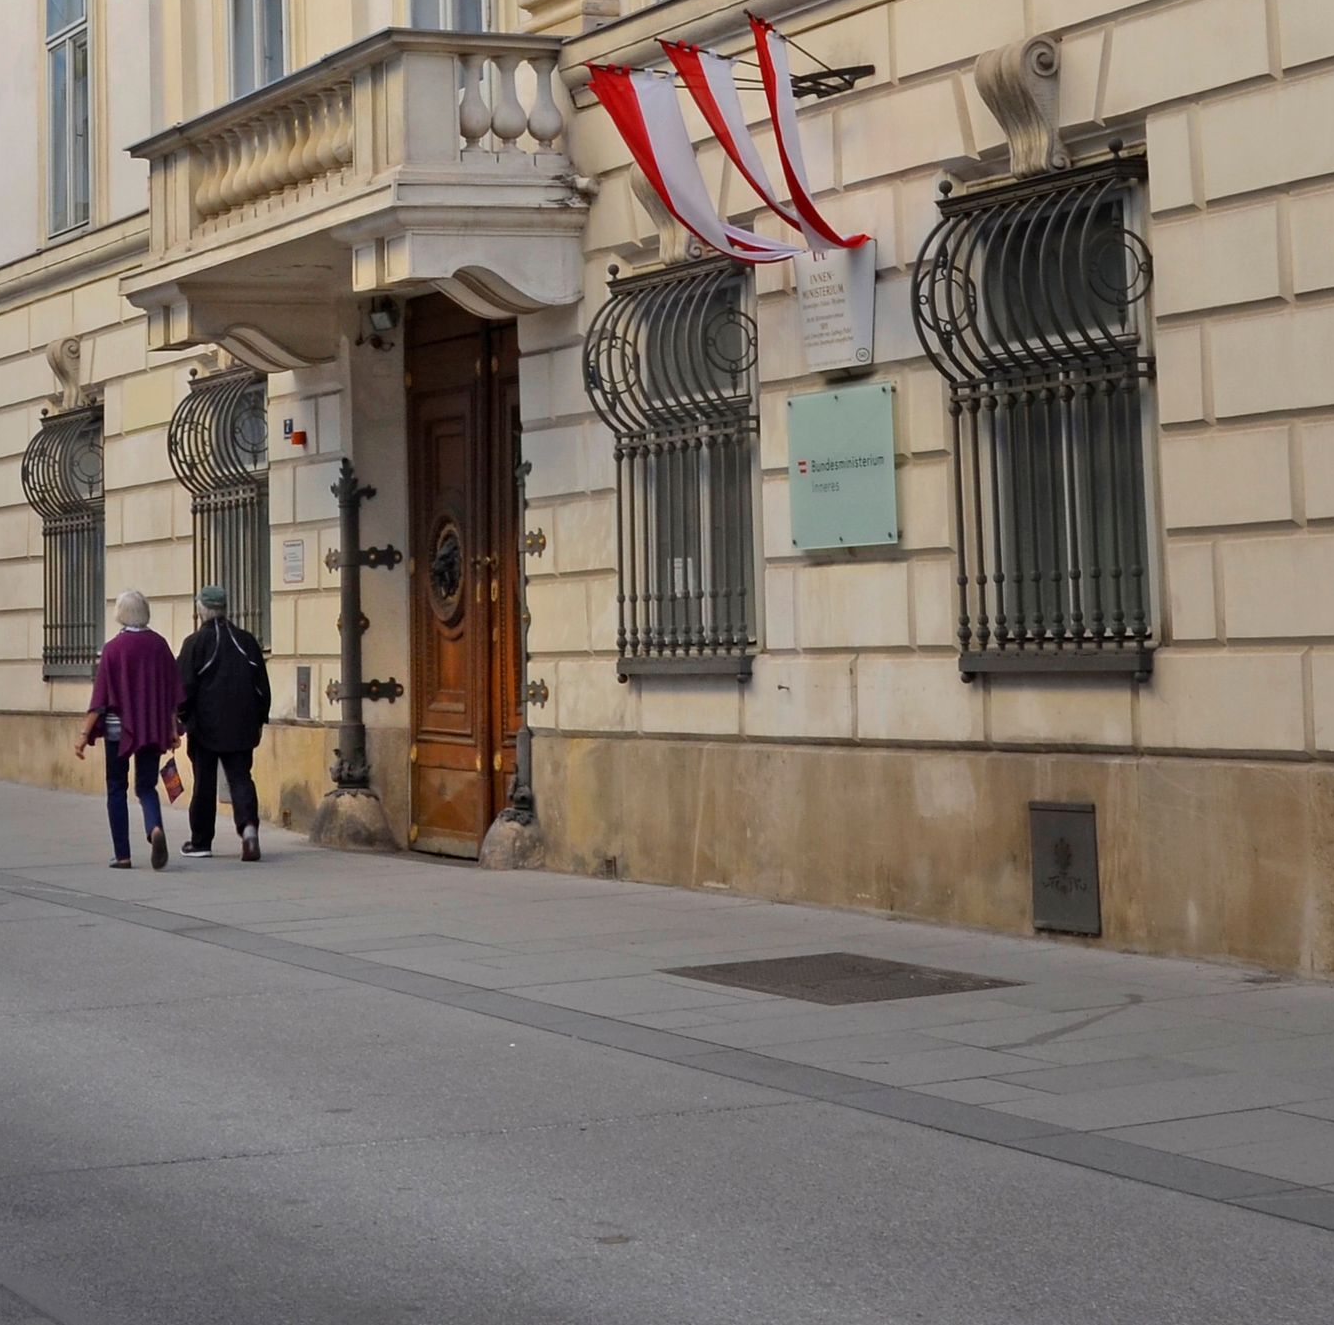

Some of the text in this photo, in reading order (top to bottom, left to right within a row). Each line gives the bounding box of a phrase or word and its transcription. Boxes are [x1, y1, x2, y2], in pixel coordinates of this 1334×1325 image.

[802, 284, 845, 299] MINISTERIUM
[811, 454, 885, 473] Bundesministerium
[811, 480, 840, 493] Inneres
